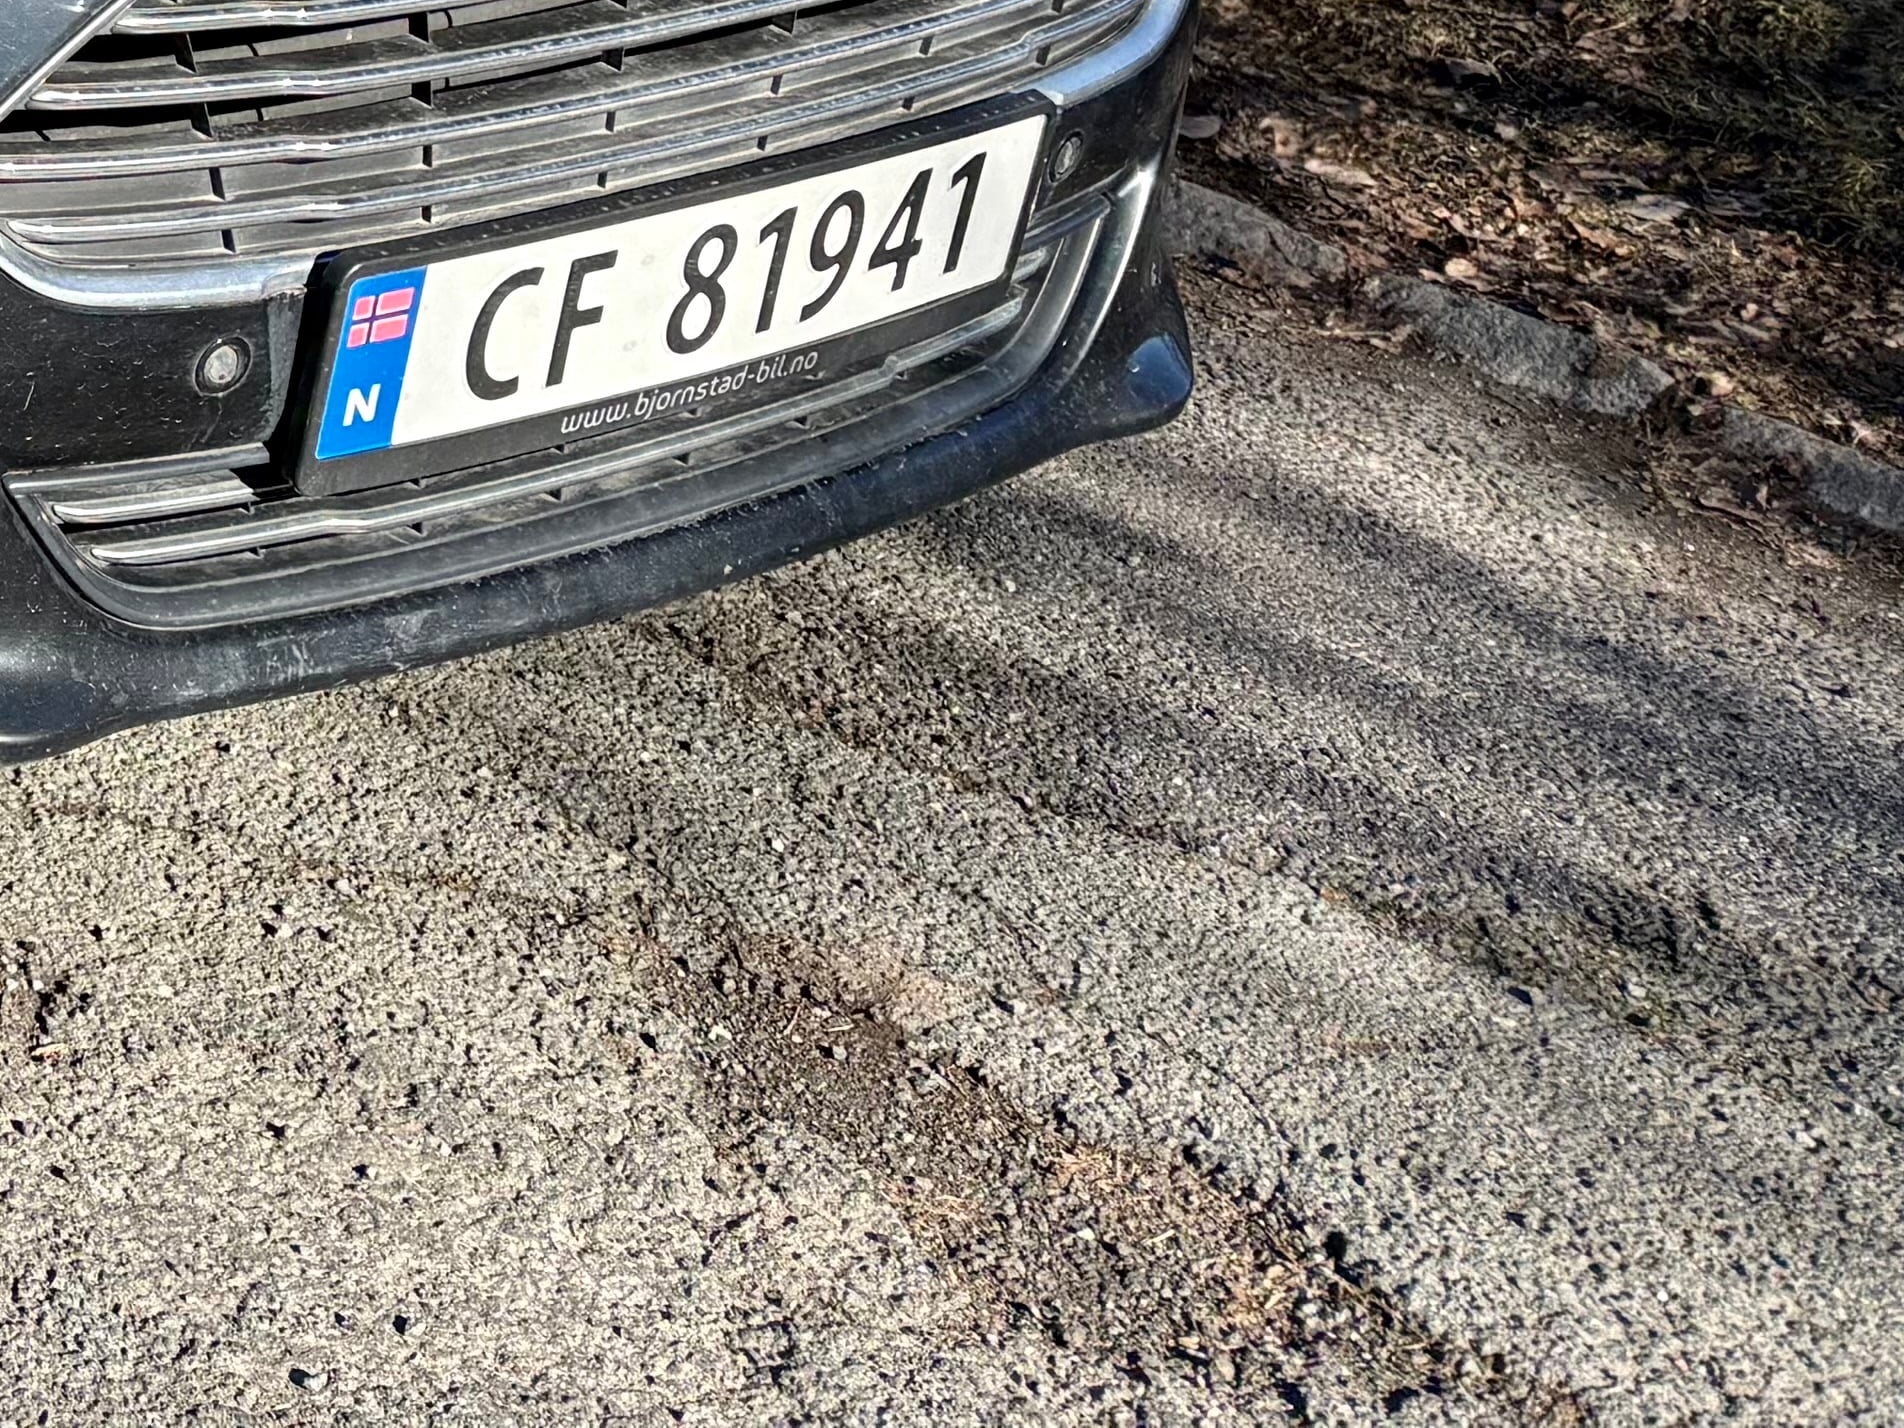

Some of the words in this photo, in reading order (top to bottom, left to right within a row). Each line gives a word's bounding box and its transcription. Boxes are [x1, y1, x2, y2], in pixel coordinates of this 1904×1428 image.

[465, 249, 619, 401] CF
[665, 151, 988, 355] 81941
[342, 383, 381, 427] N
[560, 351, 819, 434] www.bjornstad-bil.no
